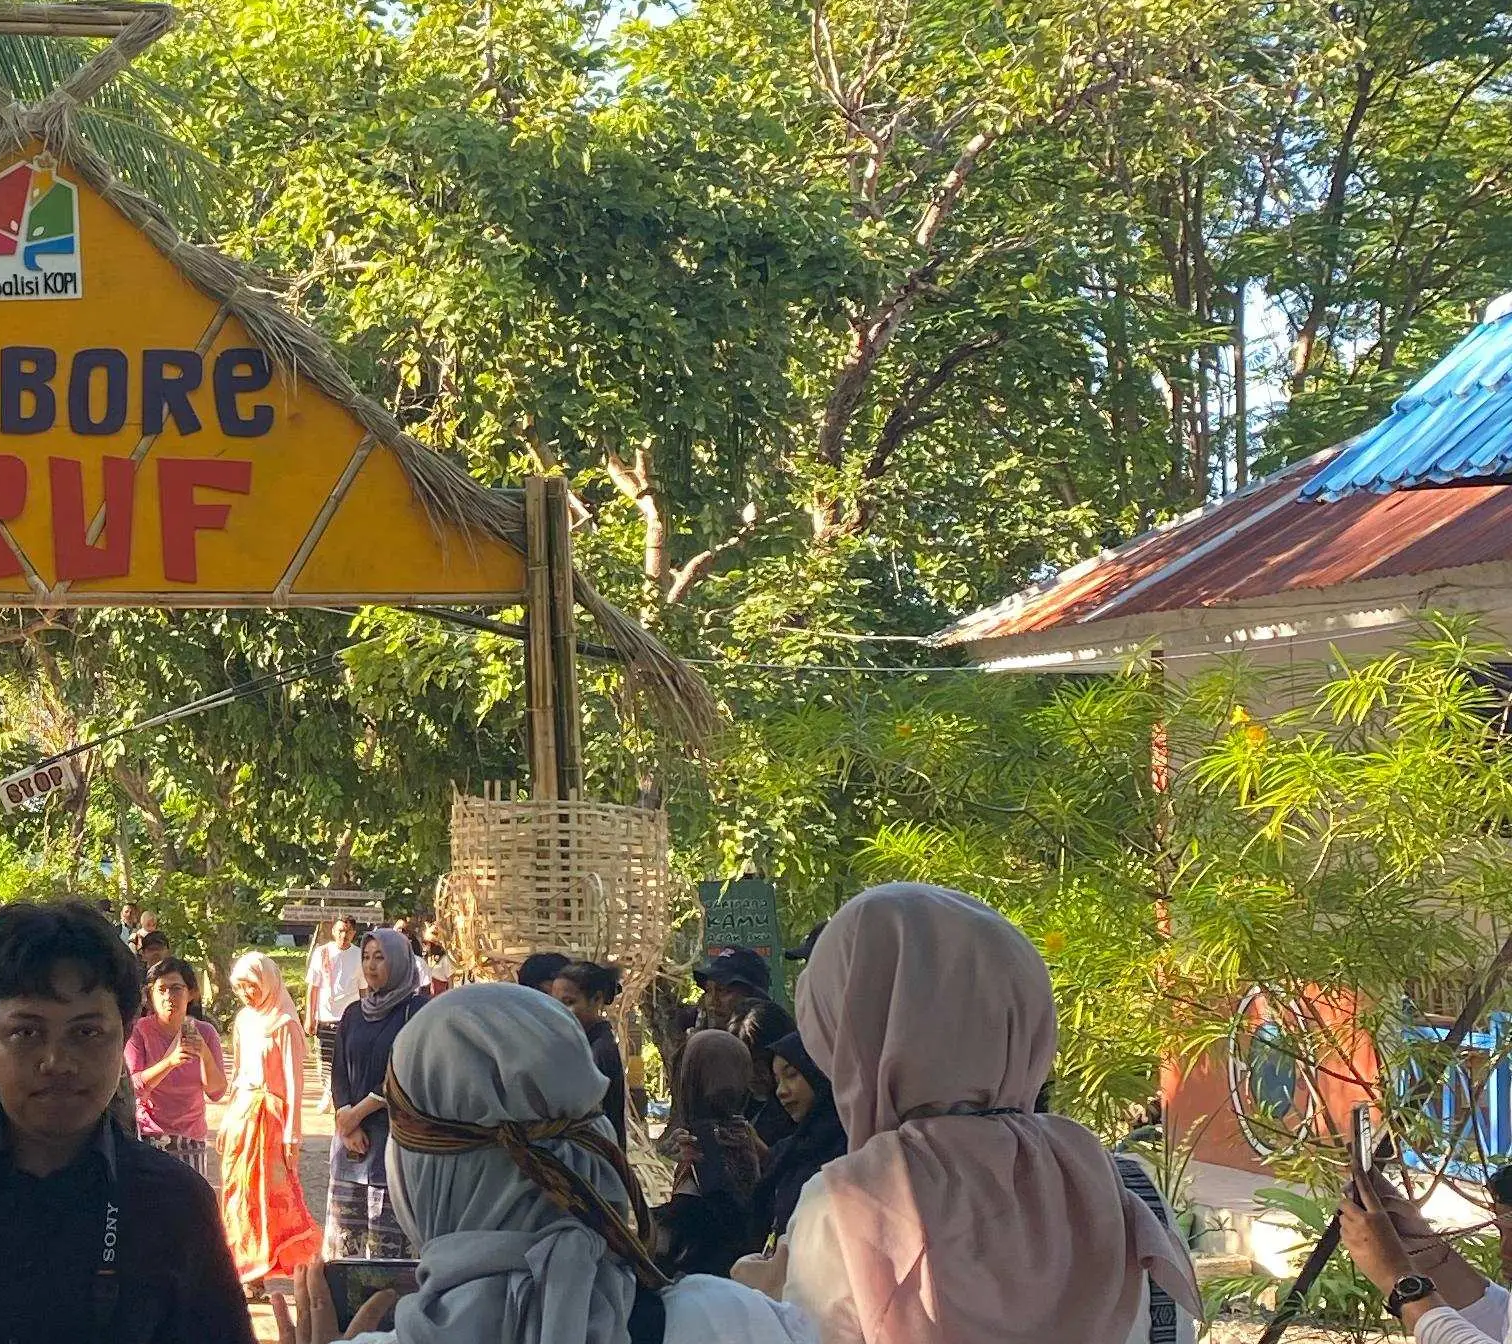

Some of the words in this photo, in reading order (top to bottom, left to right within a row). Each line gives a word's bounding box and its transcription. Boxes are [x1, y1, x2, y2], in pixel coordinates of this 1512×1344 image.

[44, 272, 77, 295] KOPI
[6, 766, 64, 804] STOP
[706, 913, 769, 929] KAMU
[103, 1202, 119, 1263] SONY
